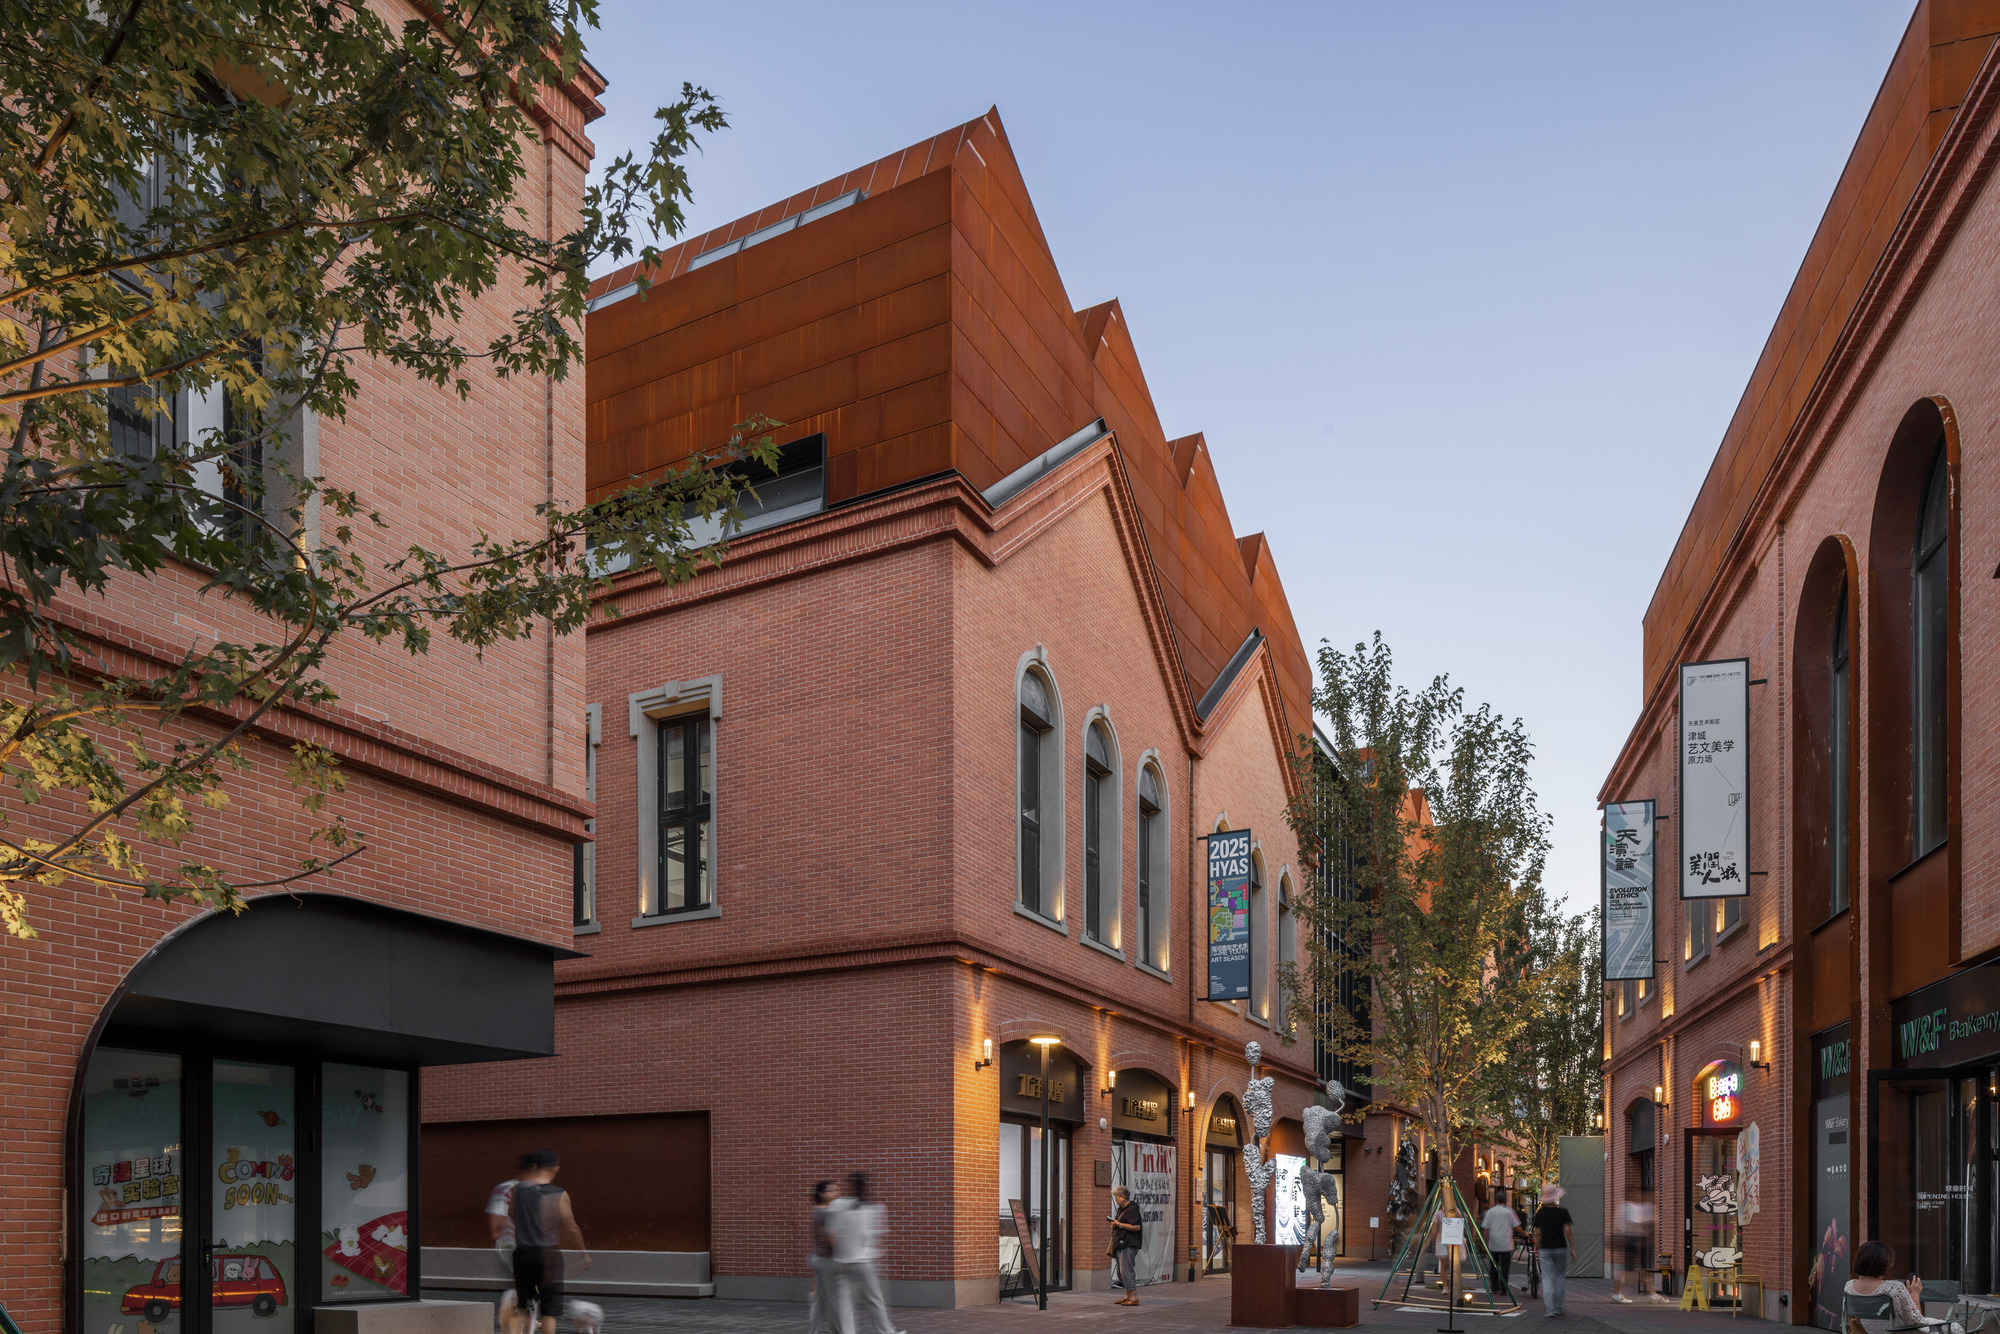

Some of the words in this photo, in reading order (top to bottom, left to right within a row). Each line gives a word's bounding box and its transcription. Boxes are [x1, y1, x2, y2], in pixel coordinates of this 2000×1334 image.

[1688, 718, 1720, 727] 天美艺术街区
[1688, 731, 1707, 741] 津城
[1688, 740, 1734, 754] 艺文美学
[1688, 755, 1713, 764] 原力场
[1210, 837, 1249, 859] 2025
[1210, 858, 1249, 877] HYAS
[1228, 946, 1249, 955] YOUTH
[1900, 1008, 1945, 1059] W&F
[1949, 1012, 2000, 1041] Bakery
[93, 1154, 172, 1186] 奇遇星球
[218, 1160, 295, 1184] COMING
[123, 1175, 179, 1204] 实验室
